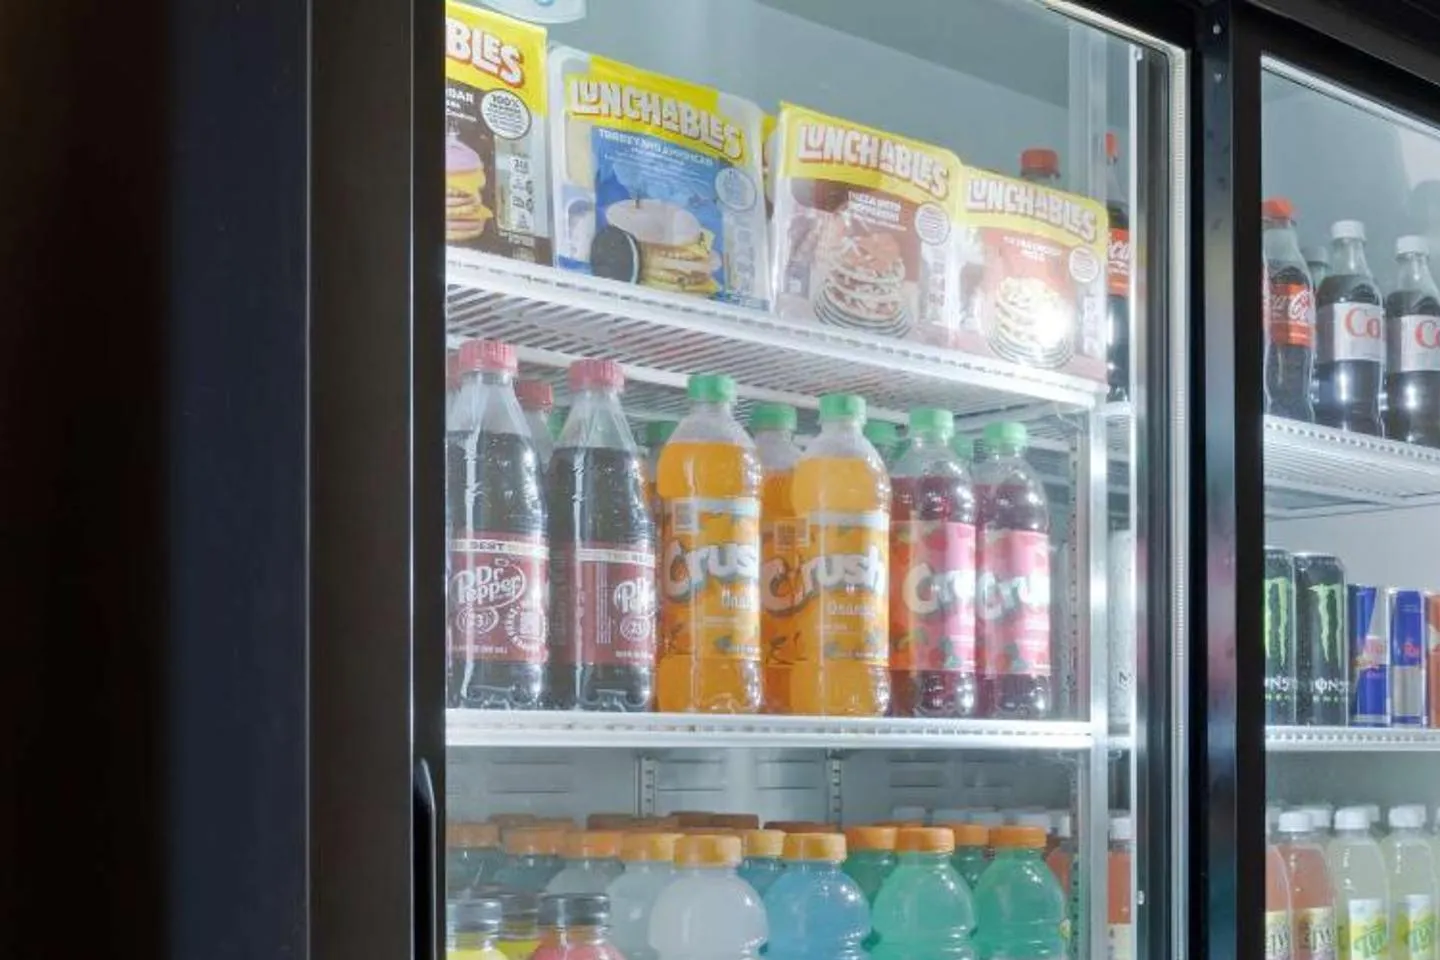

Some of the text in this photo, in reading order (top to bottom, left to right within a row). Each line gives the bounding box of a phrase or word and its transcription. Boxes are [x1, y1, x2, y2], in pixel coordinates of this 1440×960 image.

[570, 79, 744, 160] LUNCHABLES
[798, 122, 950, 199] LUNCHABLES
[965, 177, 1097, 242] LUNCHABLES
[457, 570, 521, 604] Pepper
[476, 566, 504, 582] Dr
